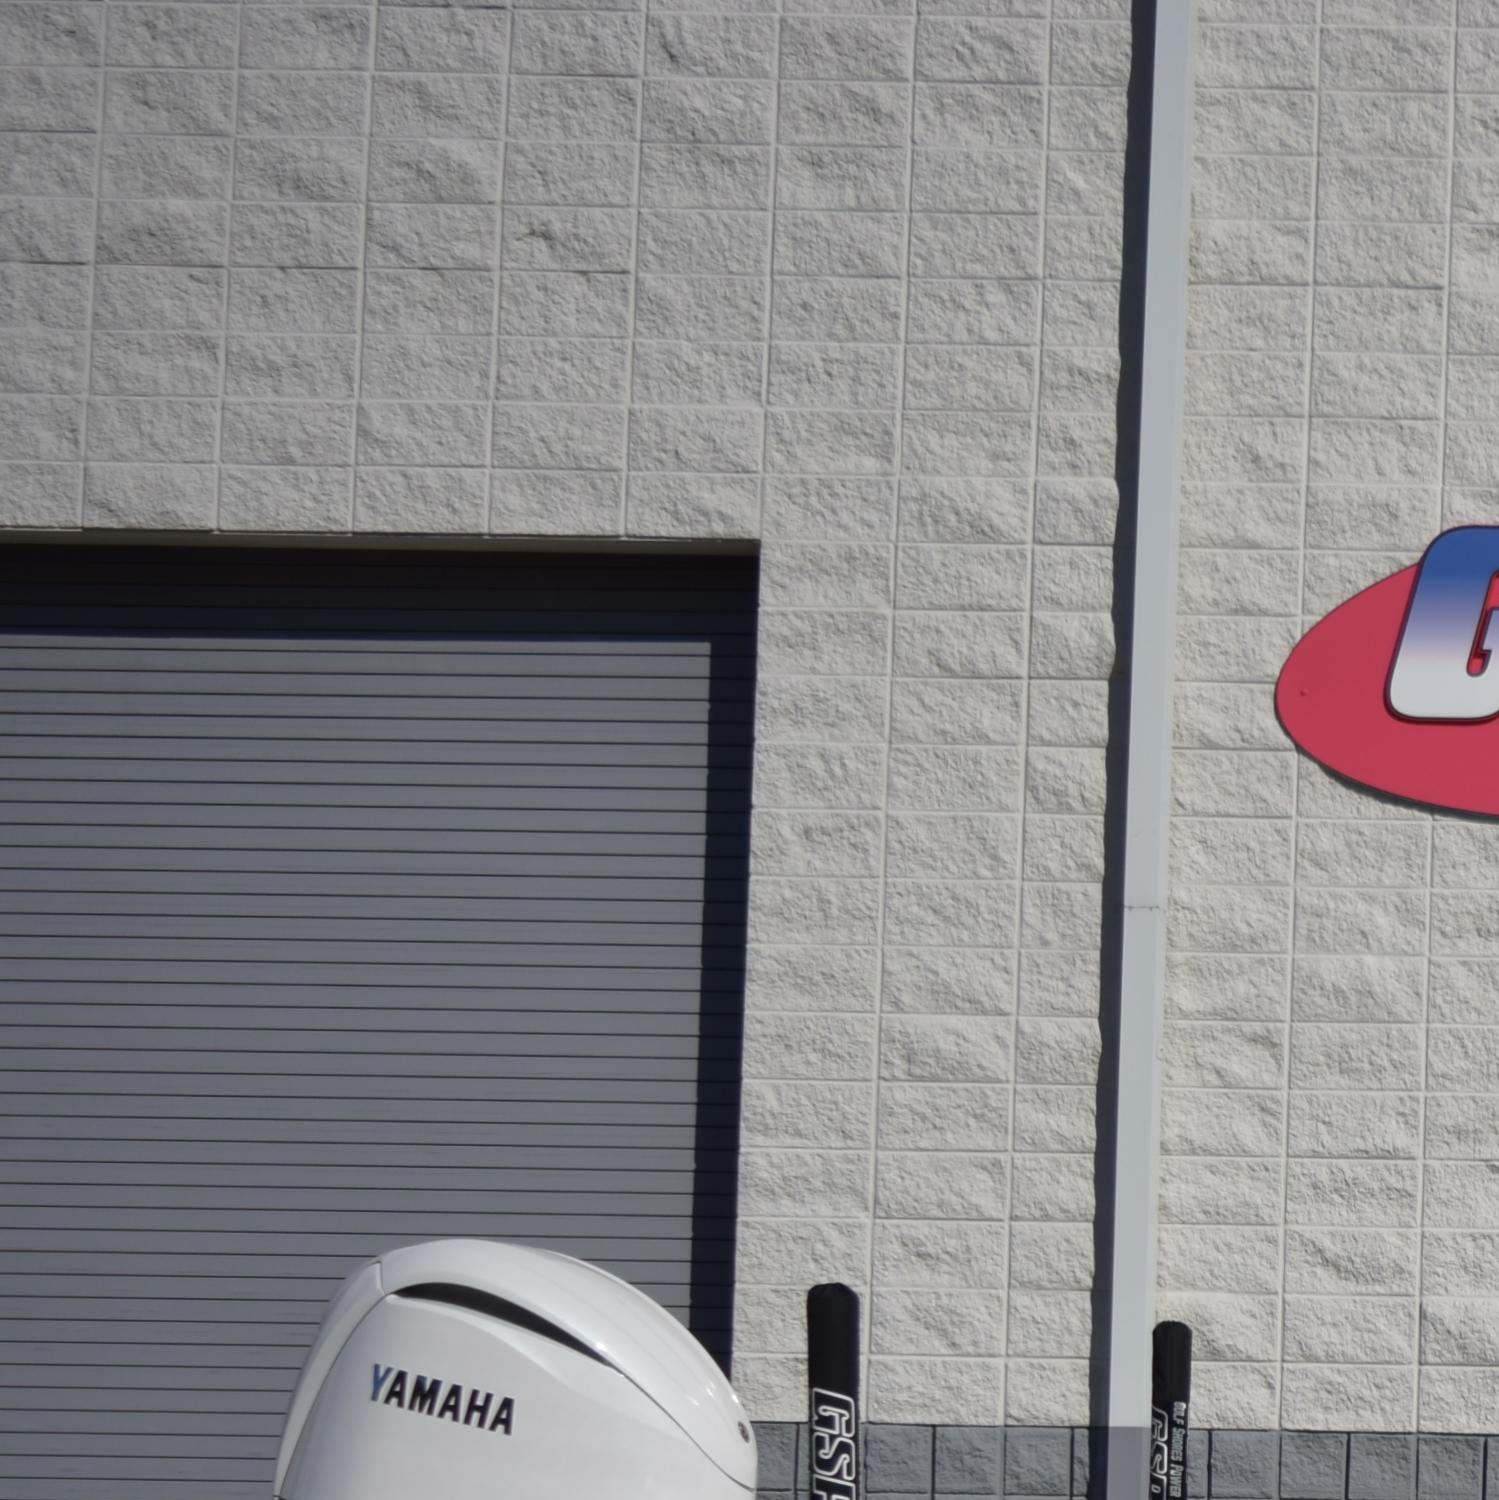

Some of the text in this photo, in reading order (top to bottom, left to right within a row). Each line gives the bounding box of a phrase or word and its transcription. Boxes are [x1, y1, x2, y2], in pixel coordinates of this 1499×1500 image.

[370, 1363, 515, 1436] YAMAHA
[1173, 1402, 1187, 1424] GULF
[1171, 1427, 1185, 1461] SHORES
[1169, 1464, 1184, 1498] POWER
